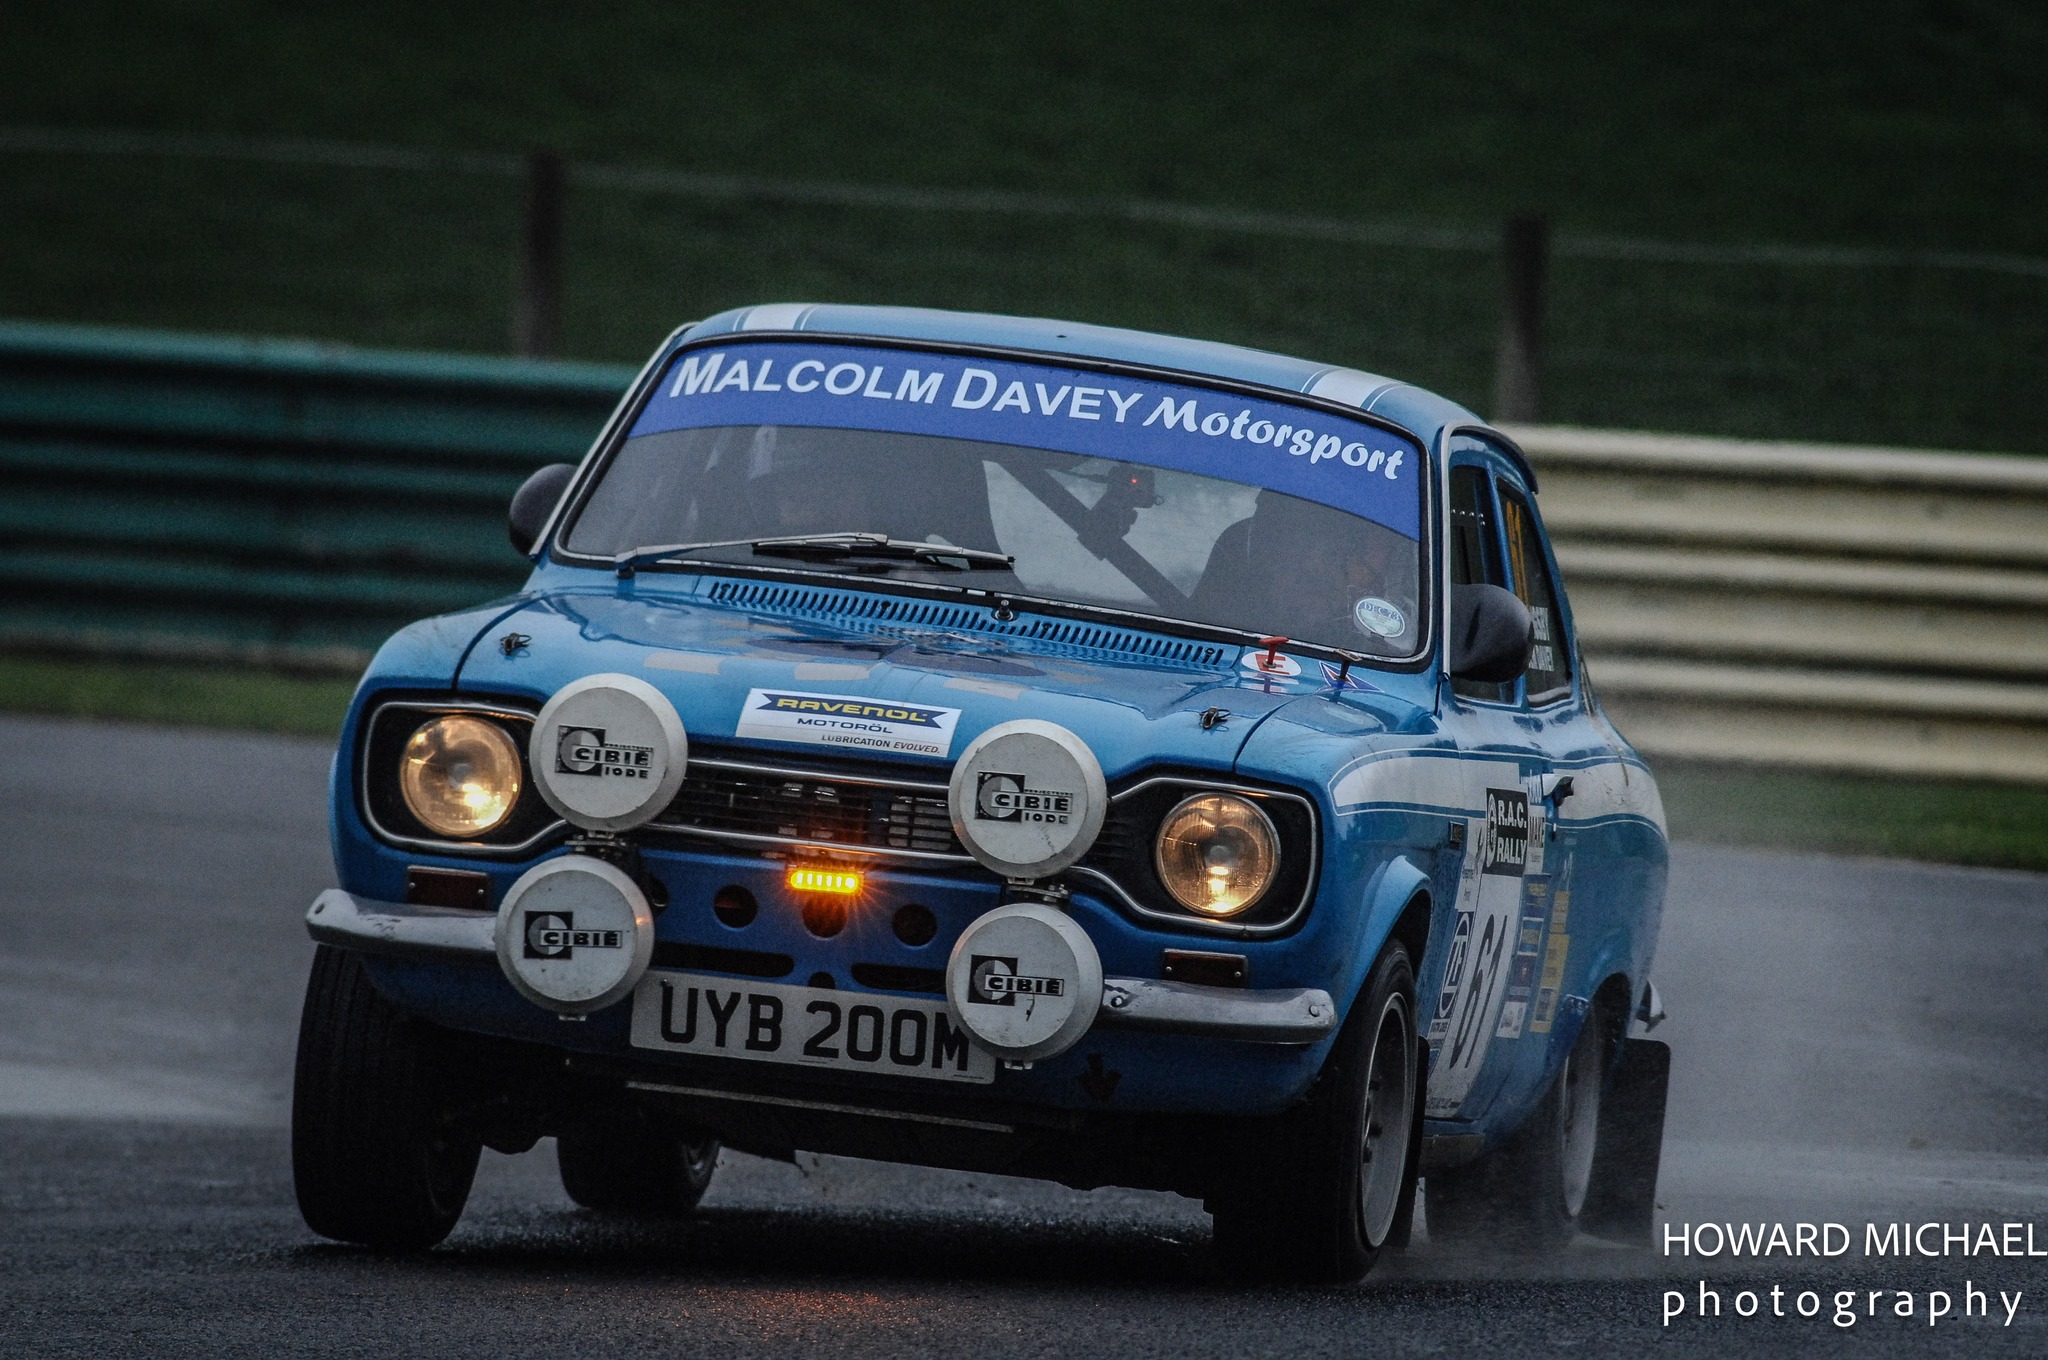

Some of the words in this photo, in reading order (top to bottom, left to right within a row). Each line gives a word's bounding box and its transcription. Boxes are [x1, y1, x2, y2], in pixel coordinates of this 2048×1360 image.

[670, 354, 945, 403] MALCOLM
[952, 368, 1144, 423] DAVEY
[1142, 397, 1404, 480] Motorsport
[777, 697, 927, 722] RAVENOL
[797, 717, 893, 734] MOTORÖL
[821, 733, 891, 748] LUBRICATION
[893, 741, 941, 754] EVOLVED.
[604, 766, 649, 779] IODE
[1497, 799, 1528, 829] R.A.C.
[1496, 836, 1527, 865] RALLY
[1449, 914, 1508, 1071] 61
[662, 984, 784, 1053] UYB
[803, 1000, 968, 1072] 200M
